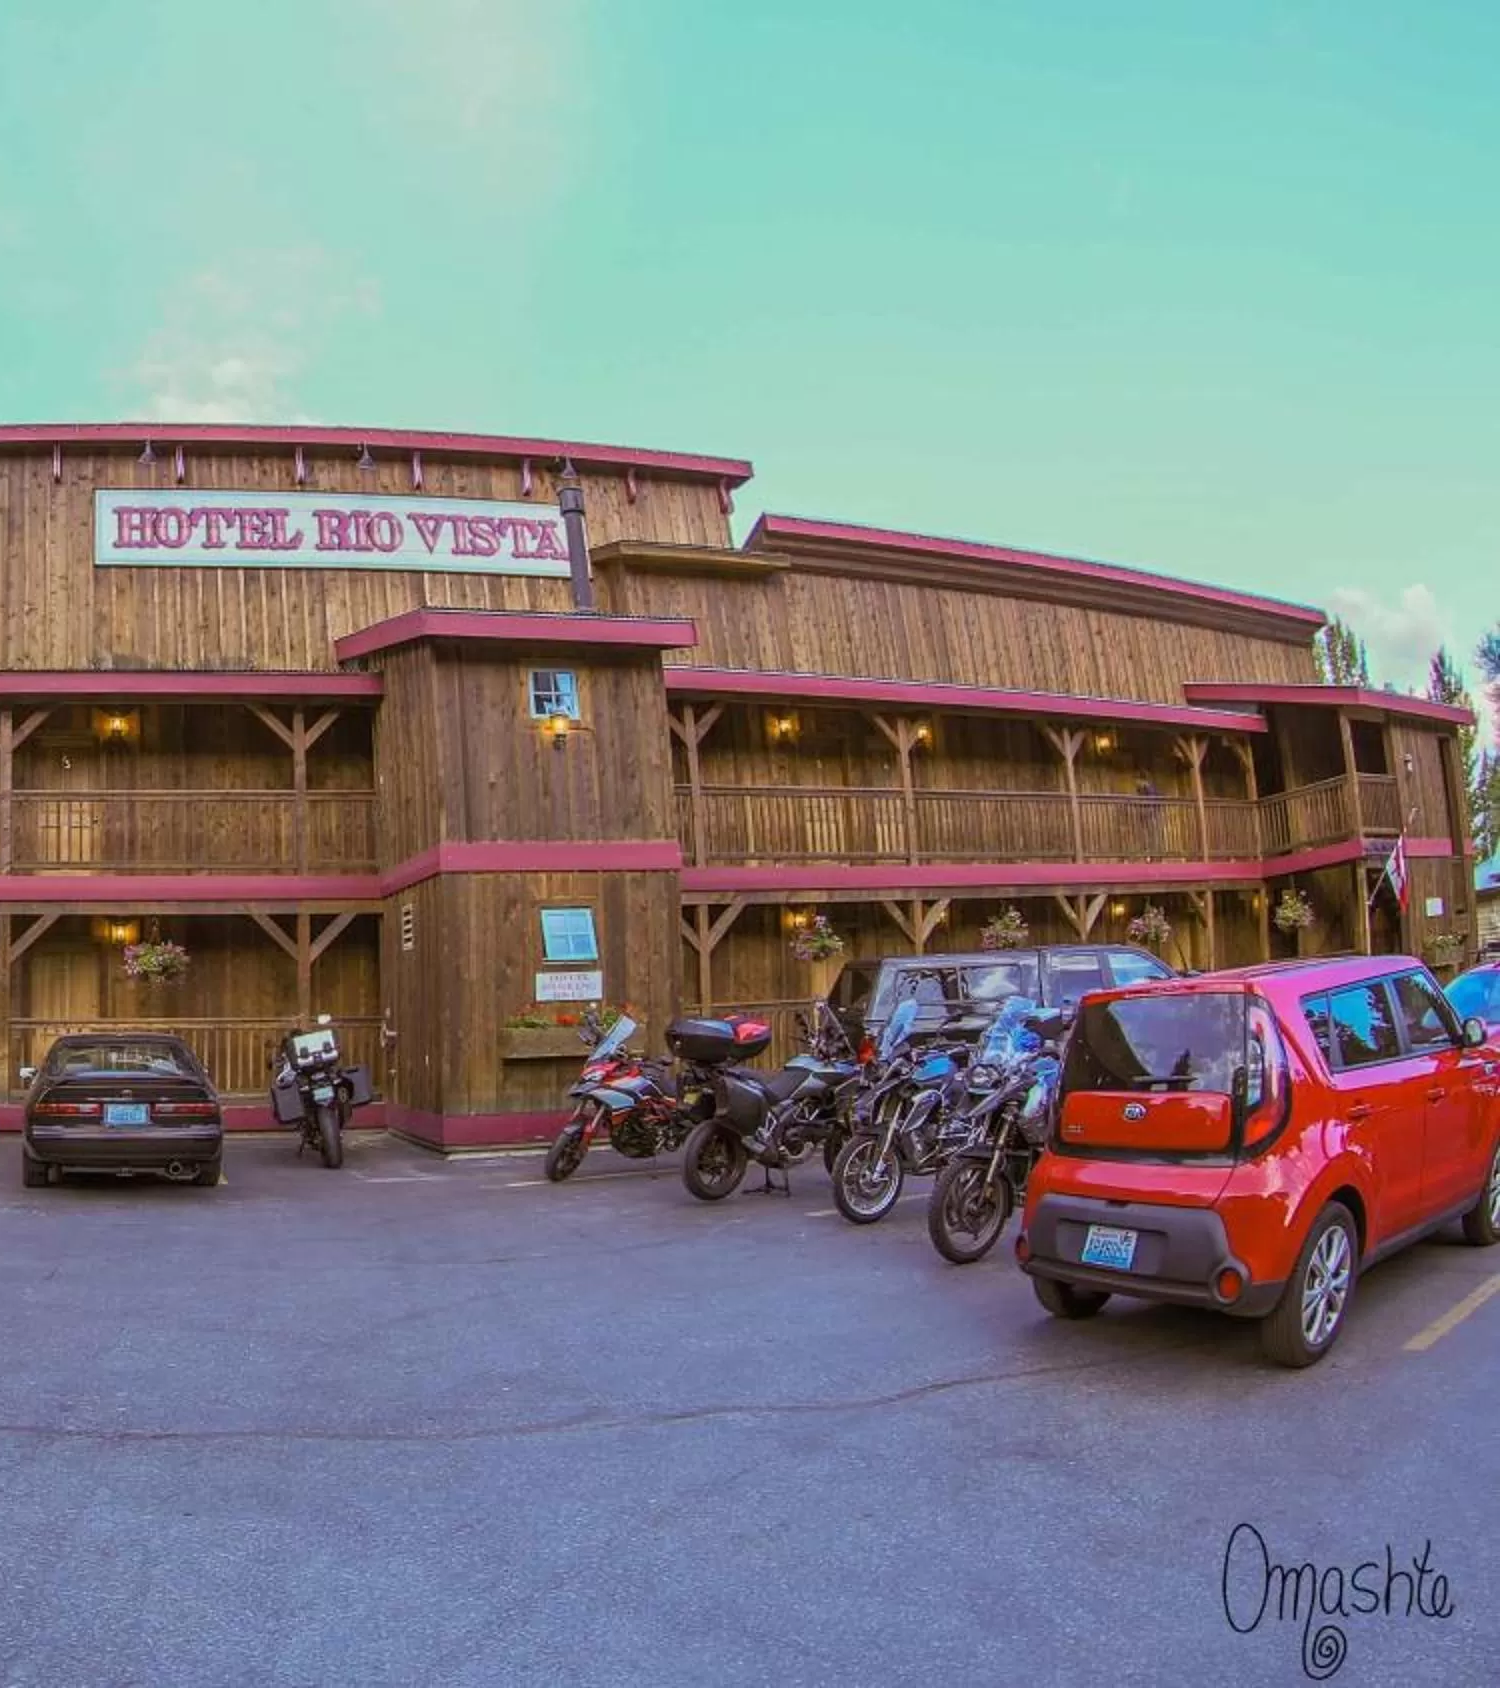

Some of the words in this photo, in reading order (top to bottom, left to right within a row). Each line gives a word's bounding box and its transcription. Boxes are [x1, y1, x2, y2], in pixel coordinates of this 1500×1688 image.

[112, 505, 303, 552] HOTEL
[313, 509, 402, 552] RIO
[406, 511, 571, 561] VISTA
